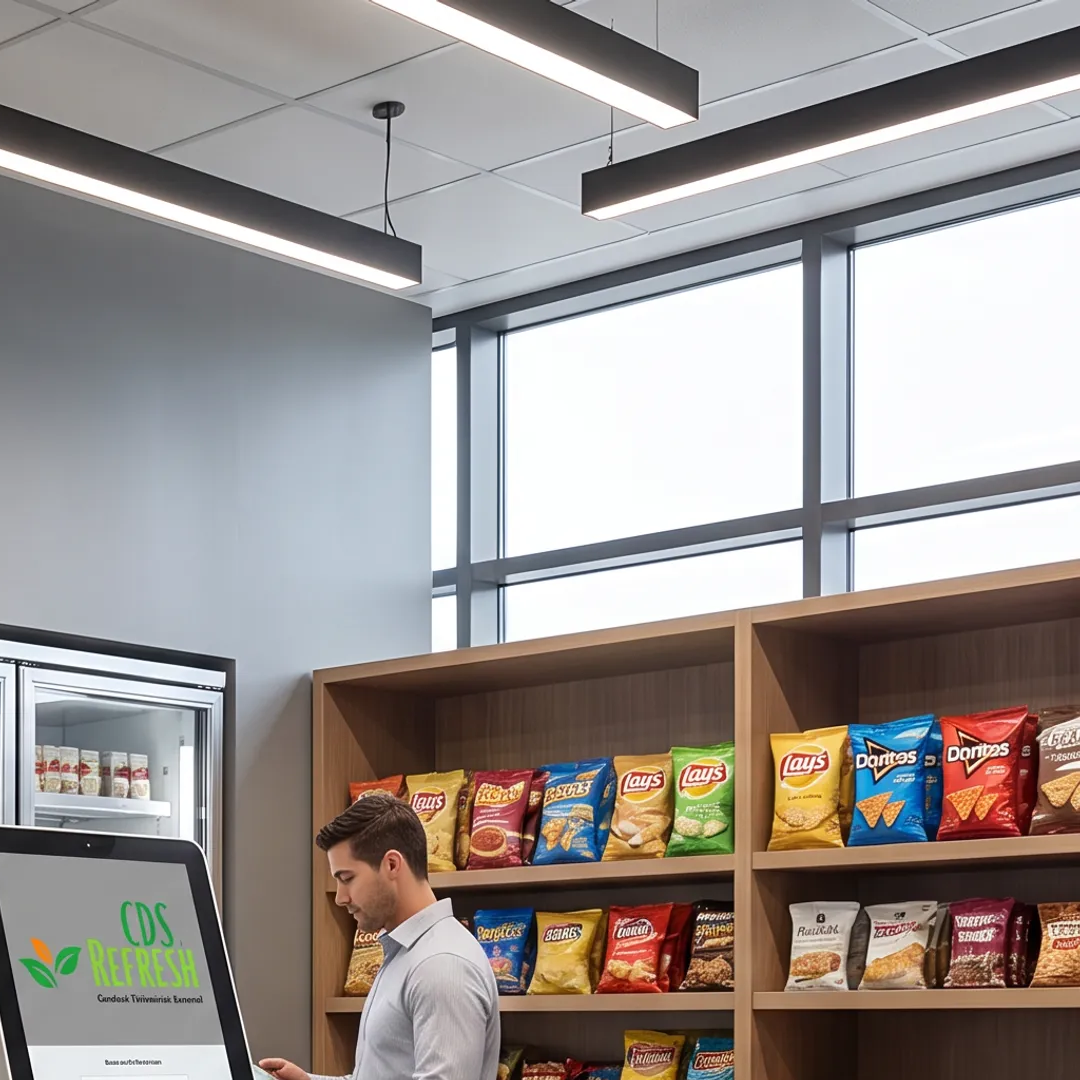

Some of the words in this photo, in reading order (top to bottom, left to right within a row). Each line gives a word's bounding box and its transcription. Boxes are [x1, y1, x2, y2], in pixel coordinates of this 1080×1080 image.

[681, 765, 724, 787] Lays
[783, 755, 826, 776] Lays
[623, 773, 662, 793] Lays
[120, 900, 174, 947] CDS
[86, 938, 200, 989] REFRESH
